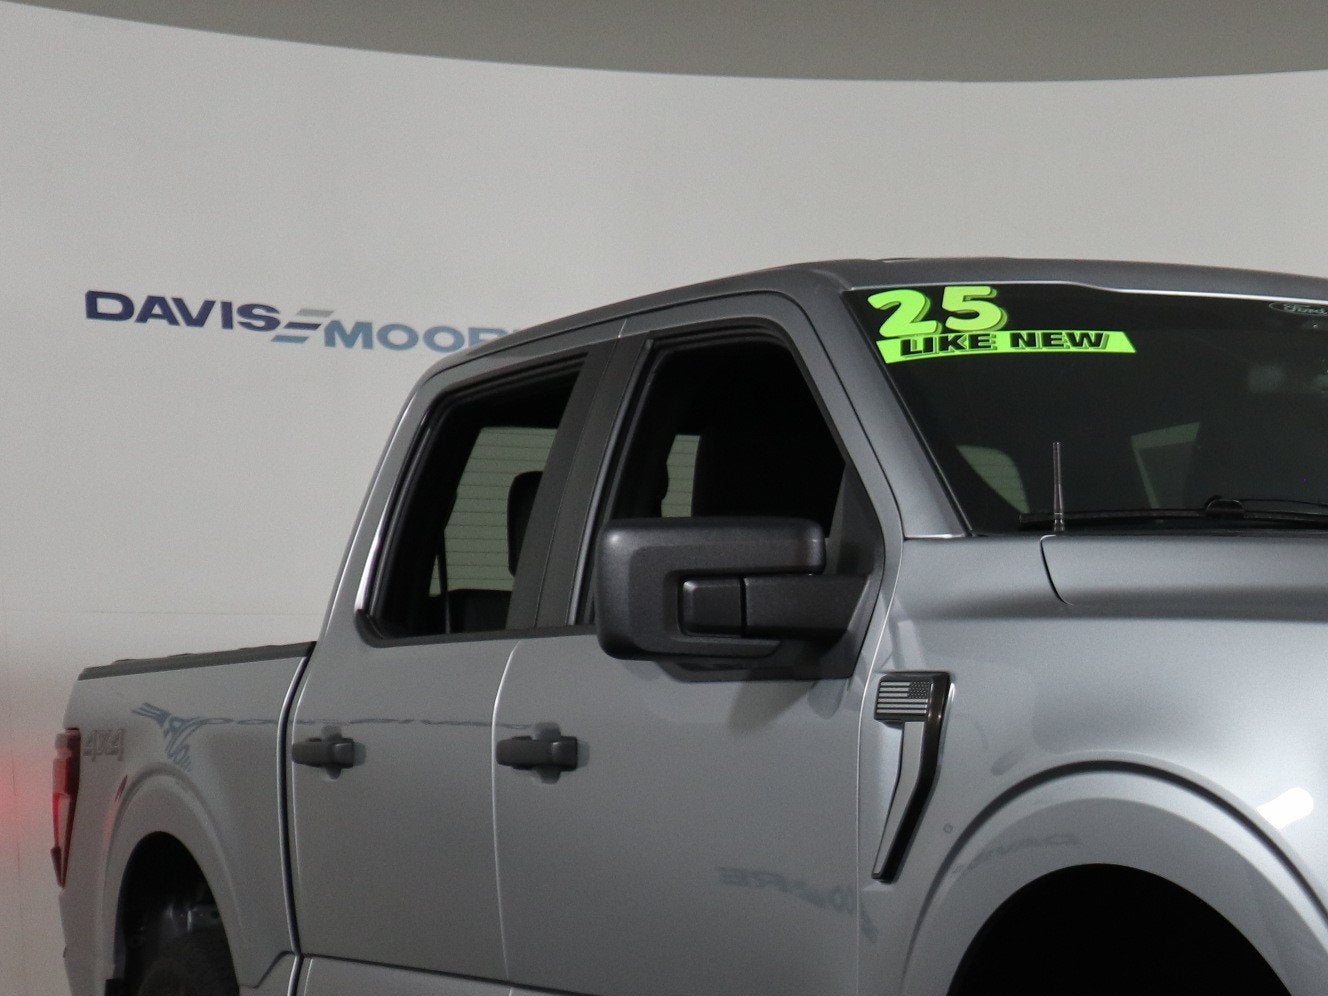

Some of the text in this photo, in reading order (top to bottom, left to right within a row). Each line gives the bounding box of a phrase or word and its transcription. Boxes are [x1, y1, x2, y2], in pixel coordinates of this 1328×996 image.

[85, 290, 511, 353] DAVIS MOOR
[867, 286, 1007, 337] 25
[900, 331, 1109, 358] LIKE NEW
